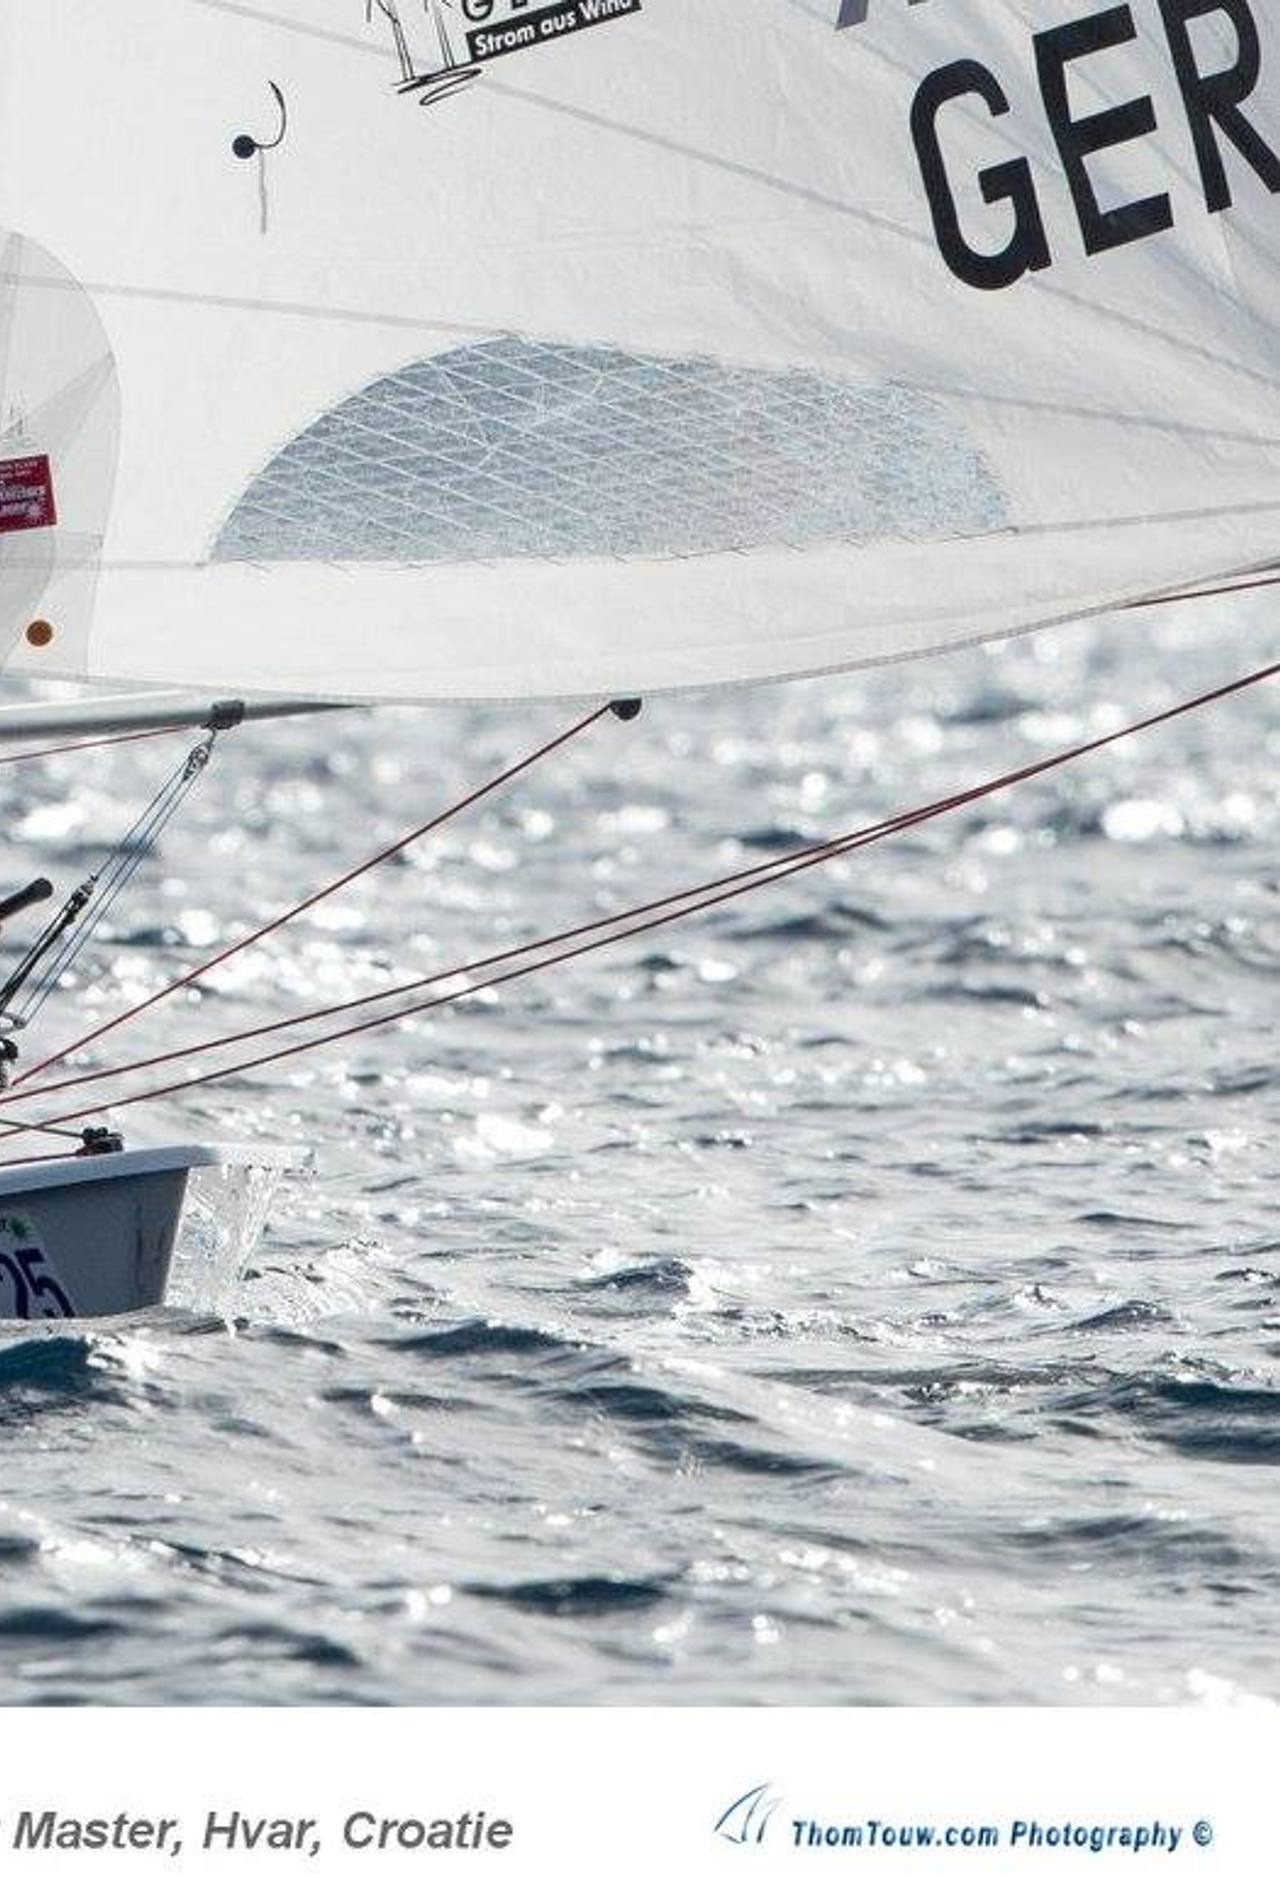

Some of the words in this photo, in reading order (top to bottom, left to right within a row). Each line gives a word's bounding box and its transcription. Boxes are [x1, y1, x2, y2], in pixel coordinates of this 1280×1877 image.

[475, 24, 535, 55] Strom
[540, 11, 576, 35] aus
[910, 0, 1280, 291] GER
